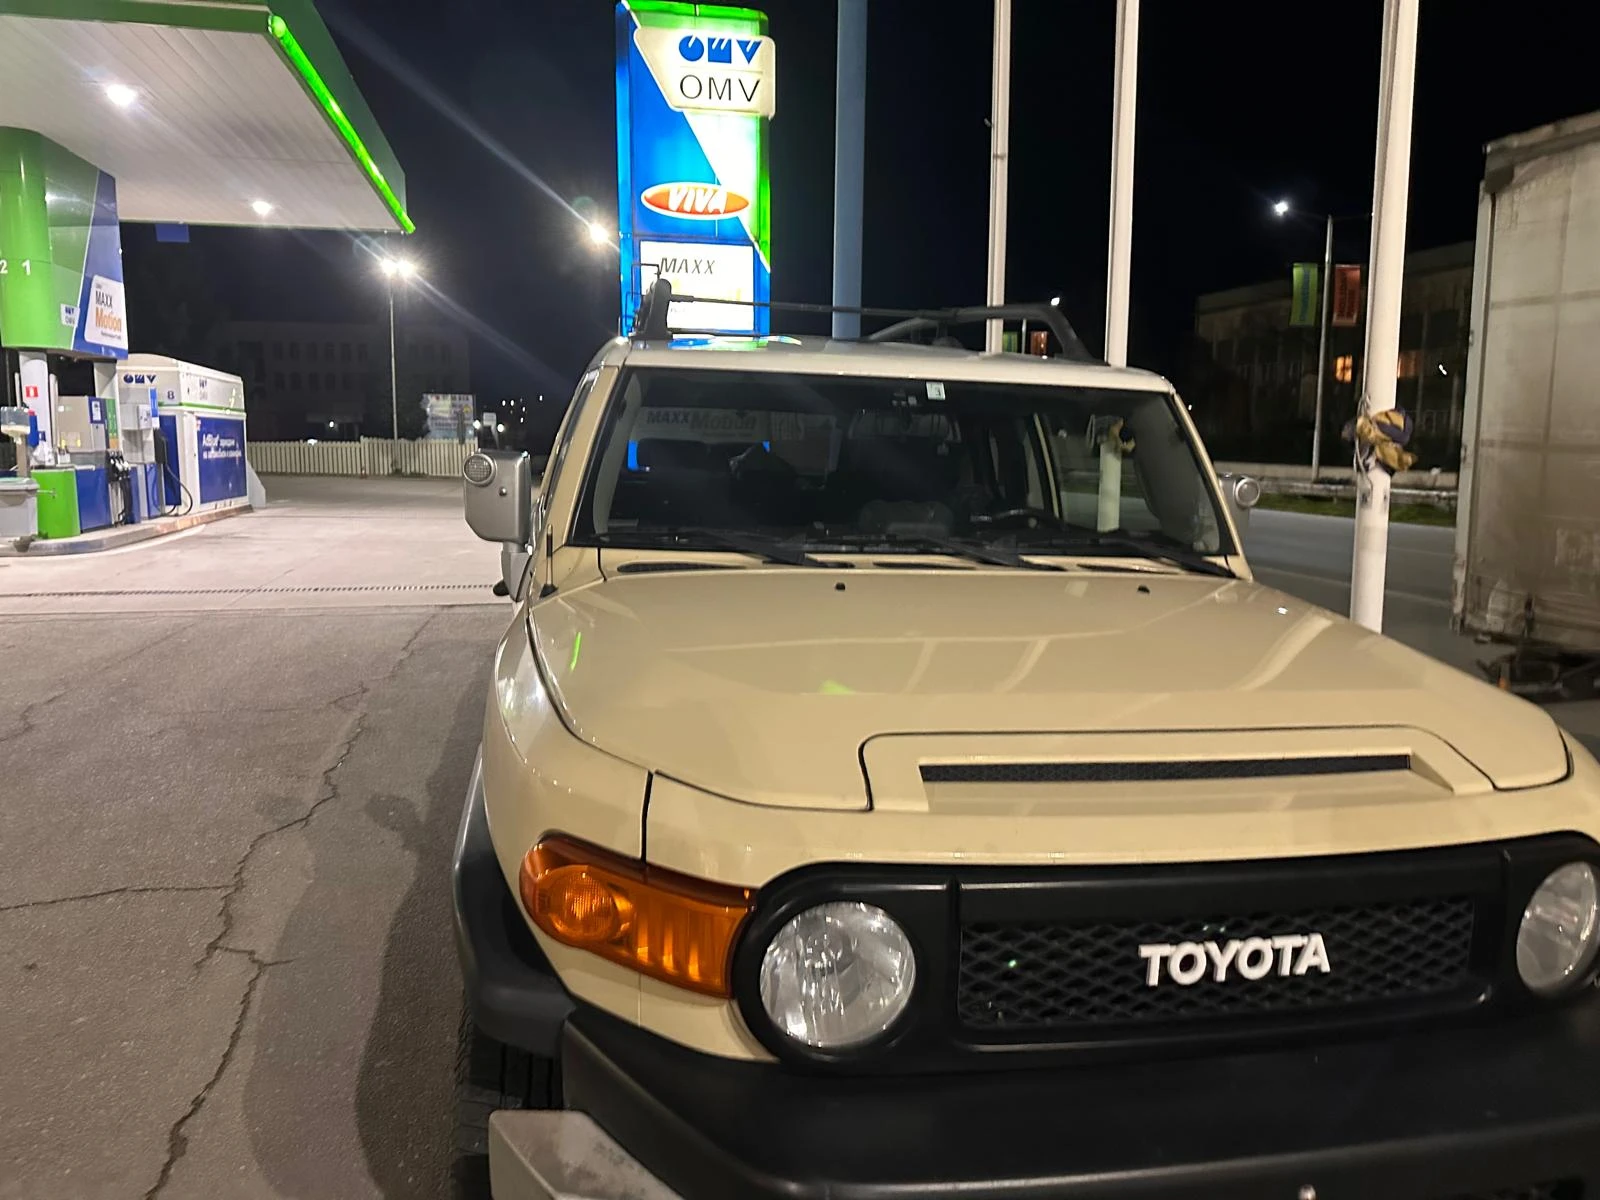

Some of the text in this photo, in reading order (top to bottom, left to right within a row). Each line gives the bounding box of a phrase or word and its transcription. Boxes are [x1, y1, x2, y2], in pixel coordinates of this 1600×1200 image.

[678, 35, 762, 64] OMV
[680, 75, 760, 102] OMV
[668, 186, 728, 214] VIVA
[0, 259, 31, 275] 2 1
[660, 257, 715, 275] MAXX
[95, 290, 112, 308] MAXX
[95, 306, 122, 332] Motion
[647, 410, 689, 424] MAXX
[1138, 932, 1330, 986] TOYOTA
